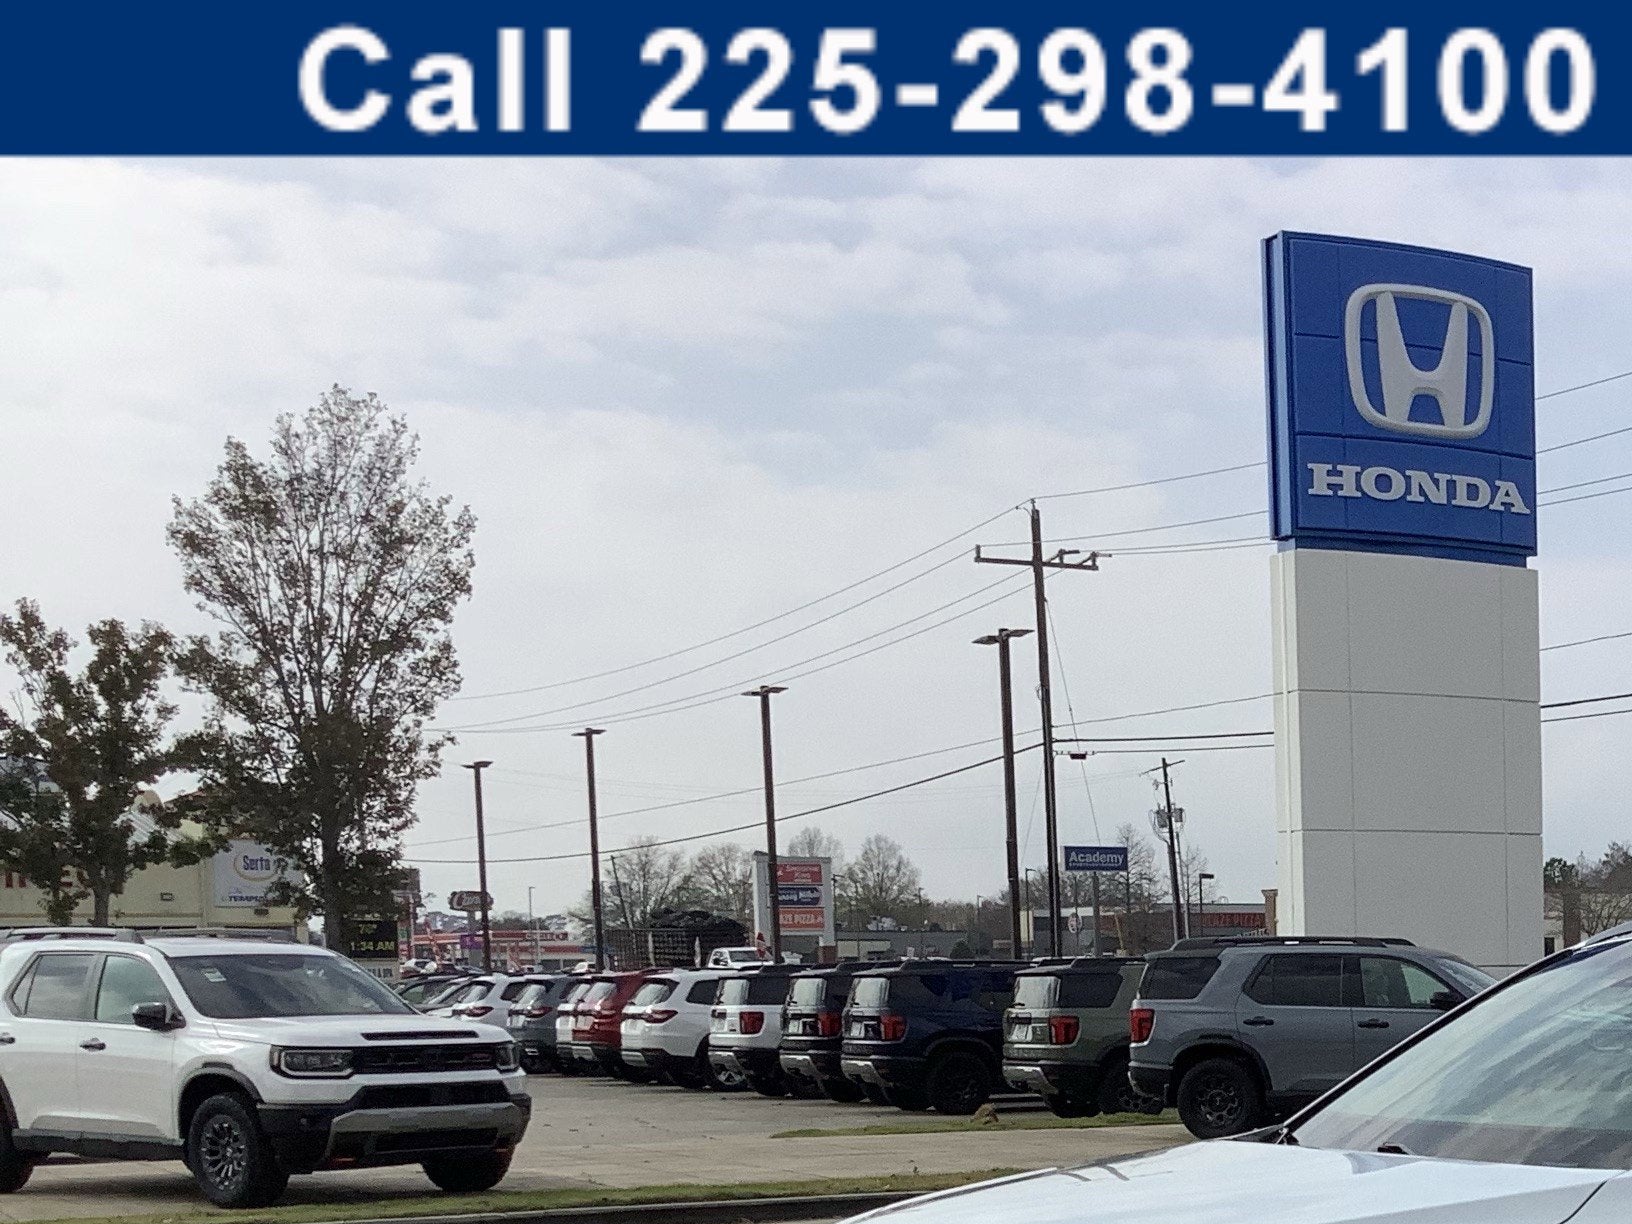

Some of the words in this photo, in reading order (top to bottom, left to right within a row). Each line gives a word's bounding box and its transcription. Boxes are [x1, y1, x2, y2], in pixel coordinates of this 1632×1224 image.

[1306, 462, 1531, 514] HONDA
[242, 854, 271, 871] Serta
[1068, 850, 1125, 866] Academy
[376, 941, 395, 951] AM
